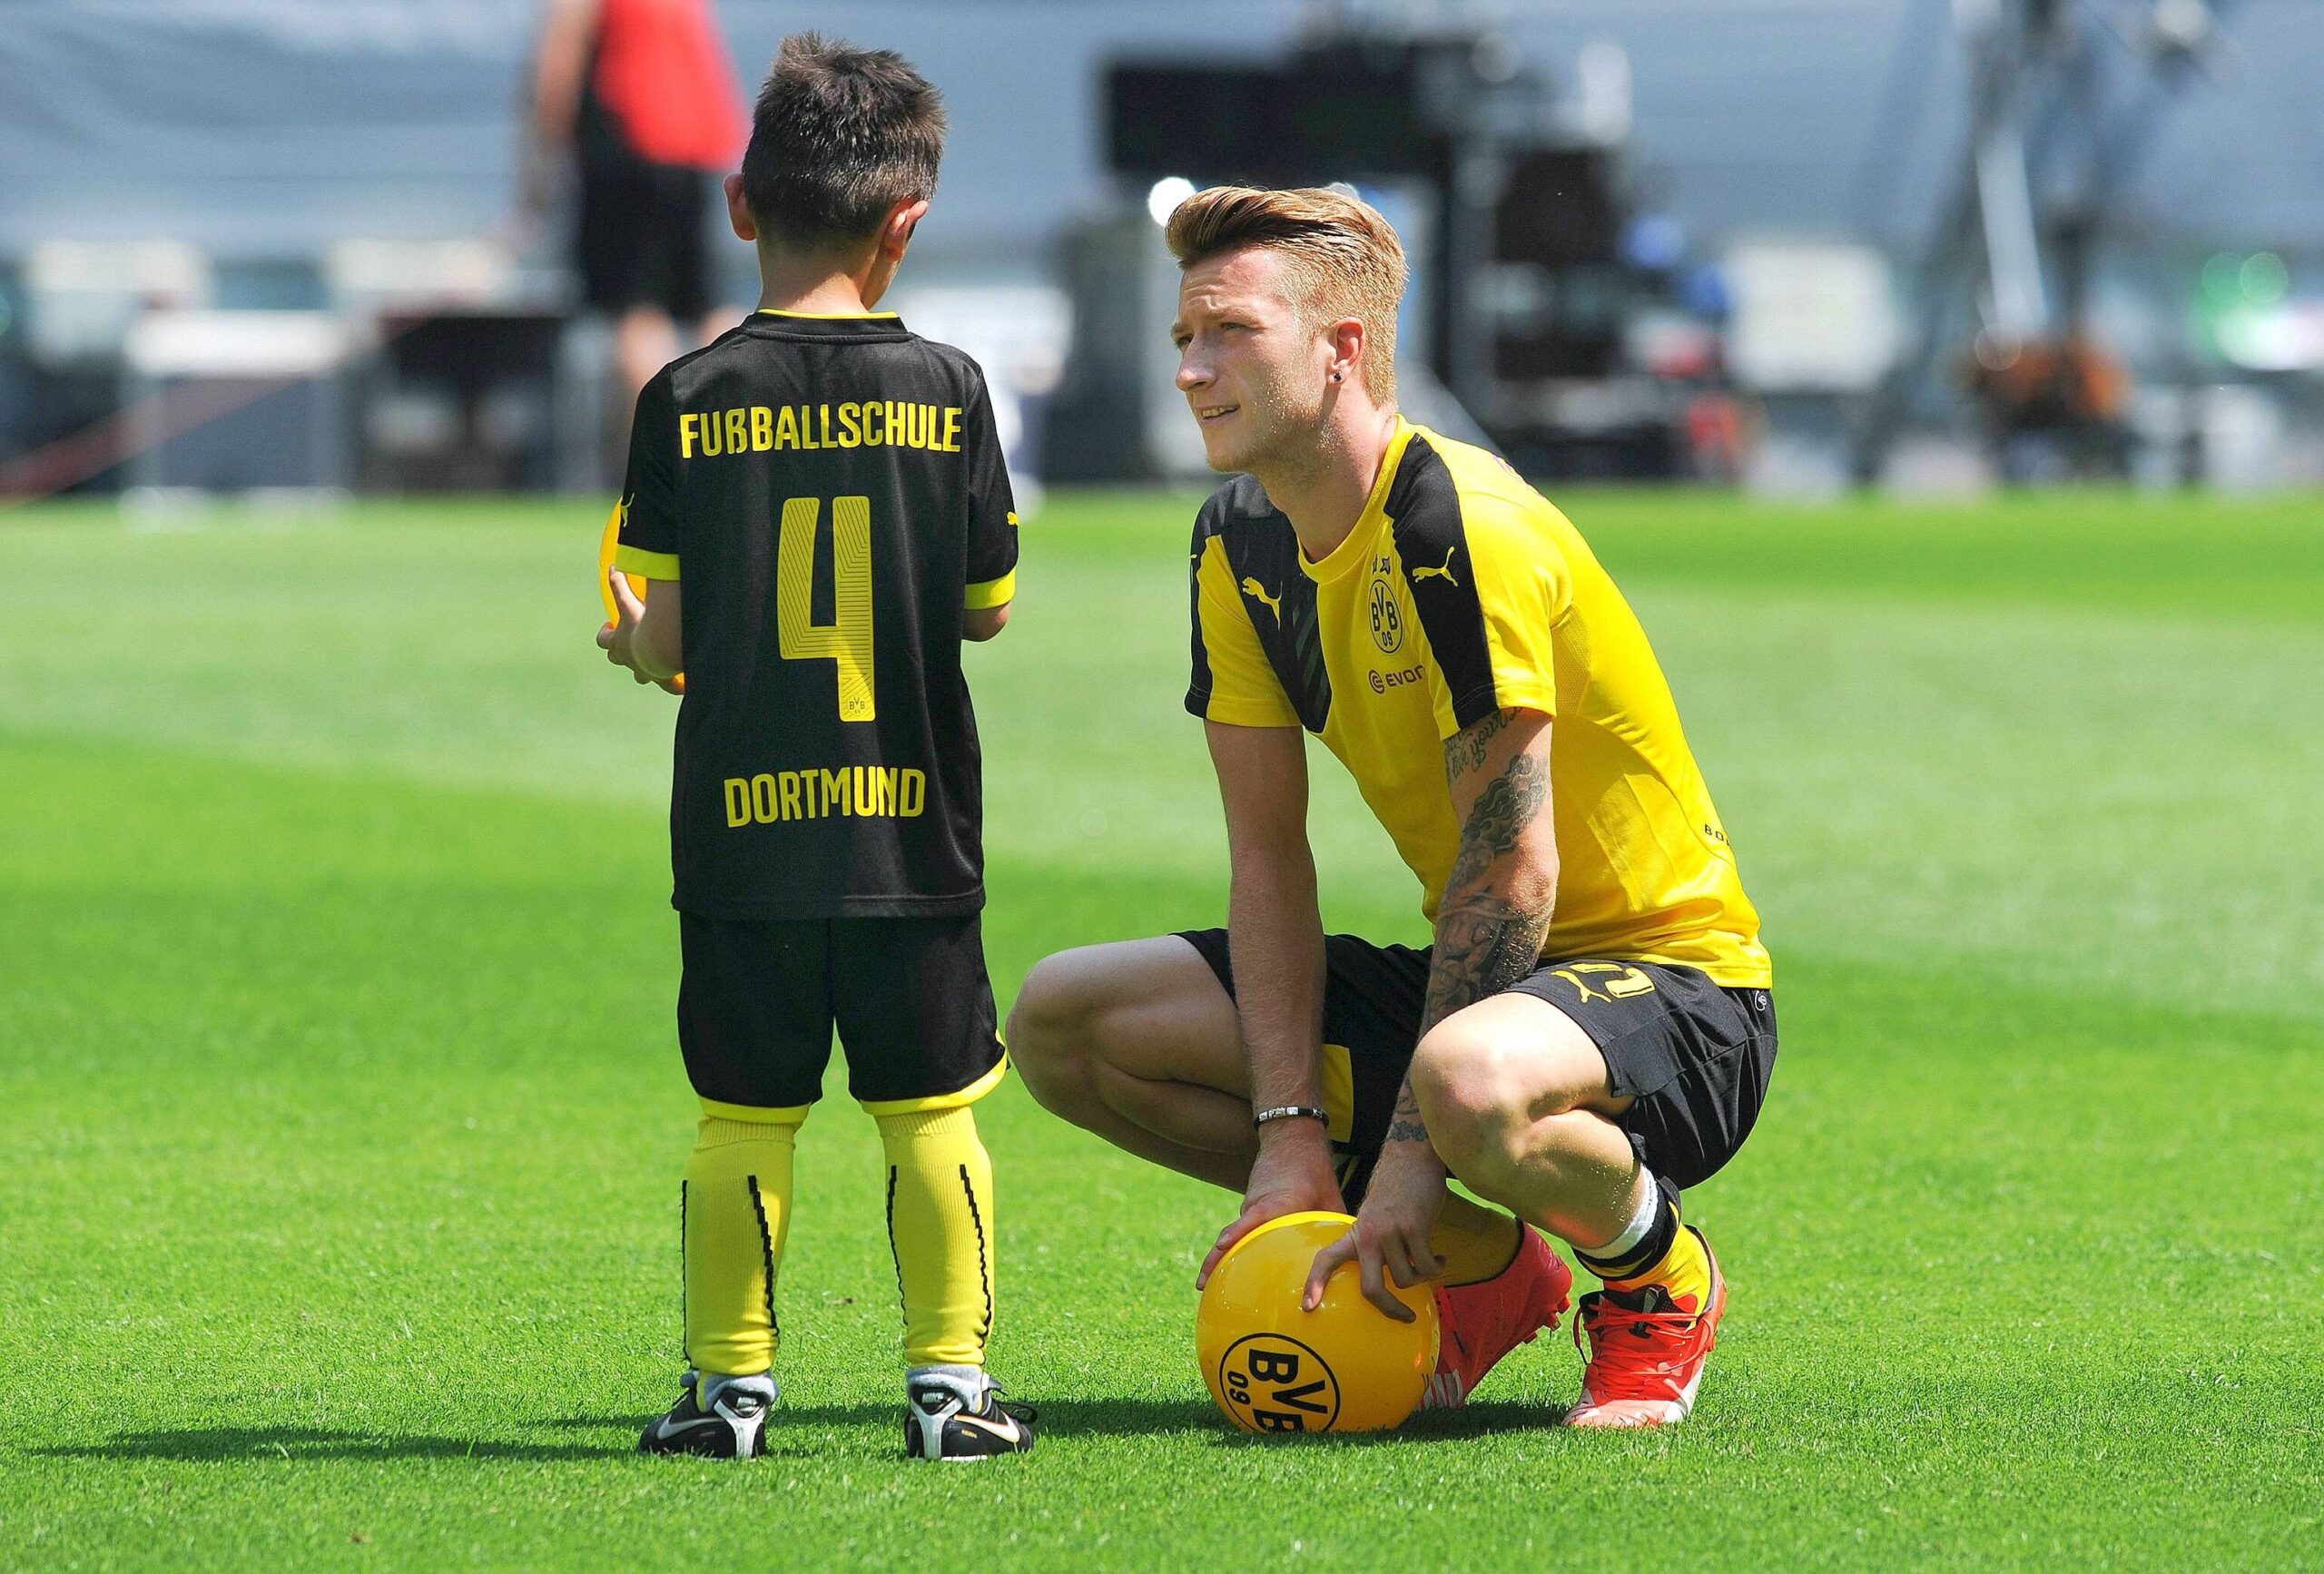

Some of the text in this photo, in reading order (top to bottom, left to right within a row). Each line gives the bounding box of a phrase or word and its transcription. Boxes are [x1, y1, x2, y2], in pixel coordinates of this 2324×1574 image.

[680, 401, 962, 458] FUßBALLSCHULE
[776, 496, 876, 722] 4
[1371, 586, 1398, 632] BVB
[1381, 631, 1393, 647] 09
[724, 765, 926, 828] DORTMUND
[1226, 1371, 1251, 1405] 09
[1248, 1349, 1328, 1432] BVB
